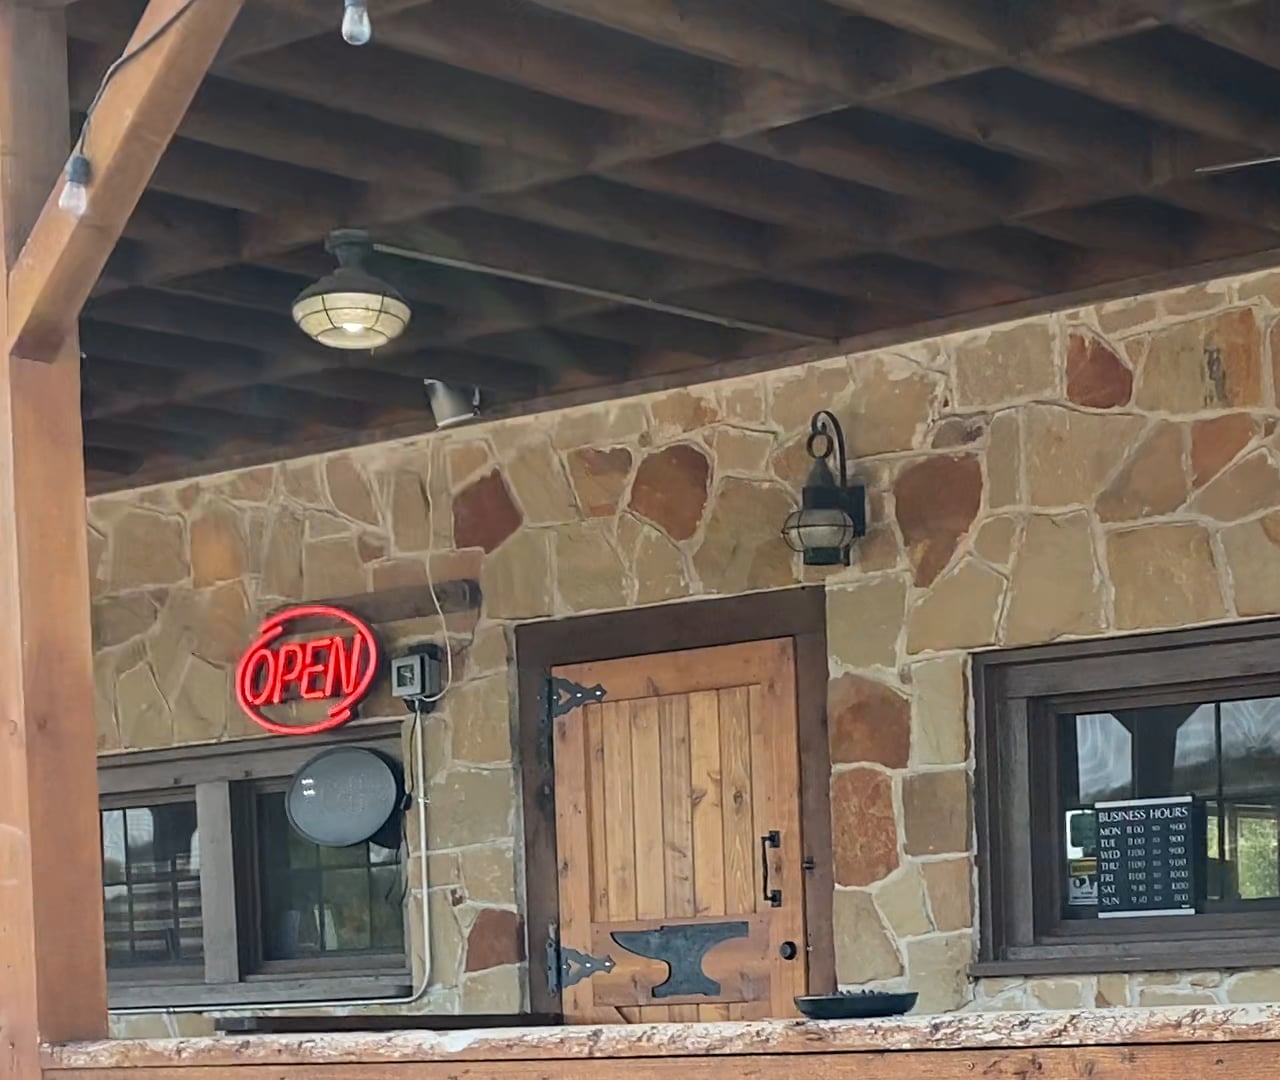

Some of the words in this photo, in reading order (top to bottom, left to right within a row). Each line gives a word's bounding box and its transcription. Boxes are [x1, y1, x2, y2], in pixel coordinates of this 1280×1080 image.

[245, 632, 364, 706] OPEN
[1098, 809, 1146, 823] BUSINESS
[1150, 806, 1188, 819] HOURS
[1100, 826, 1121, 836] MON
